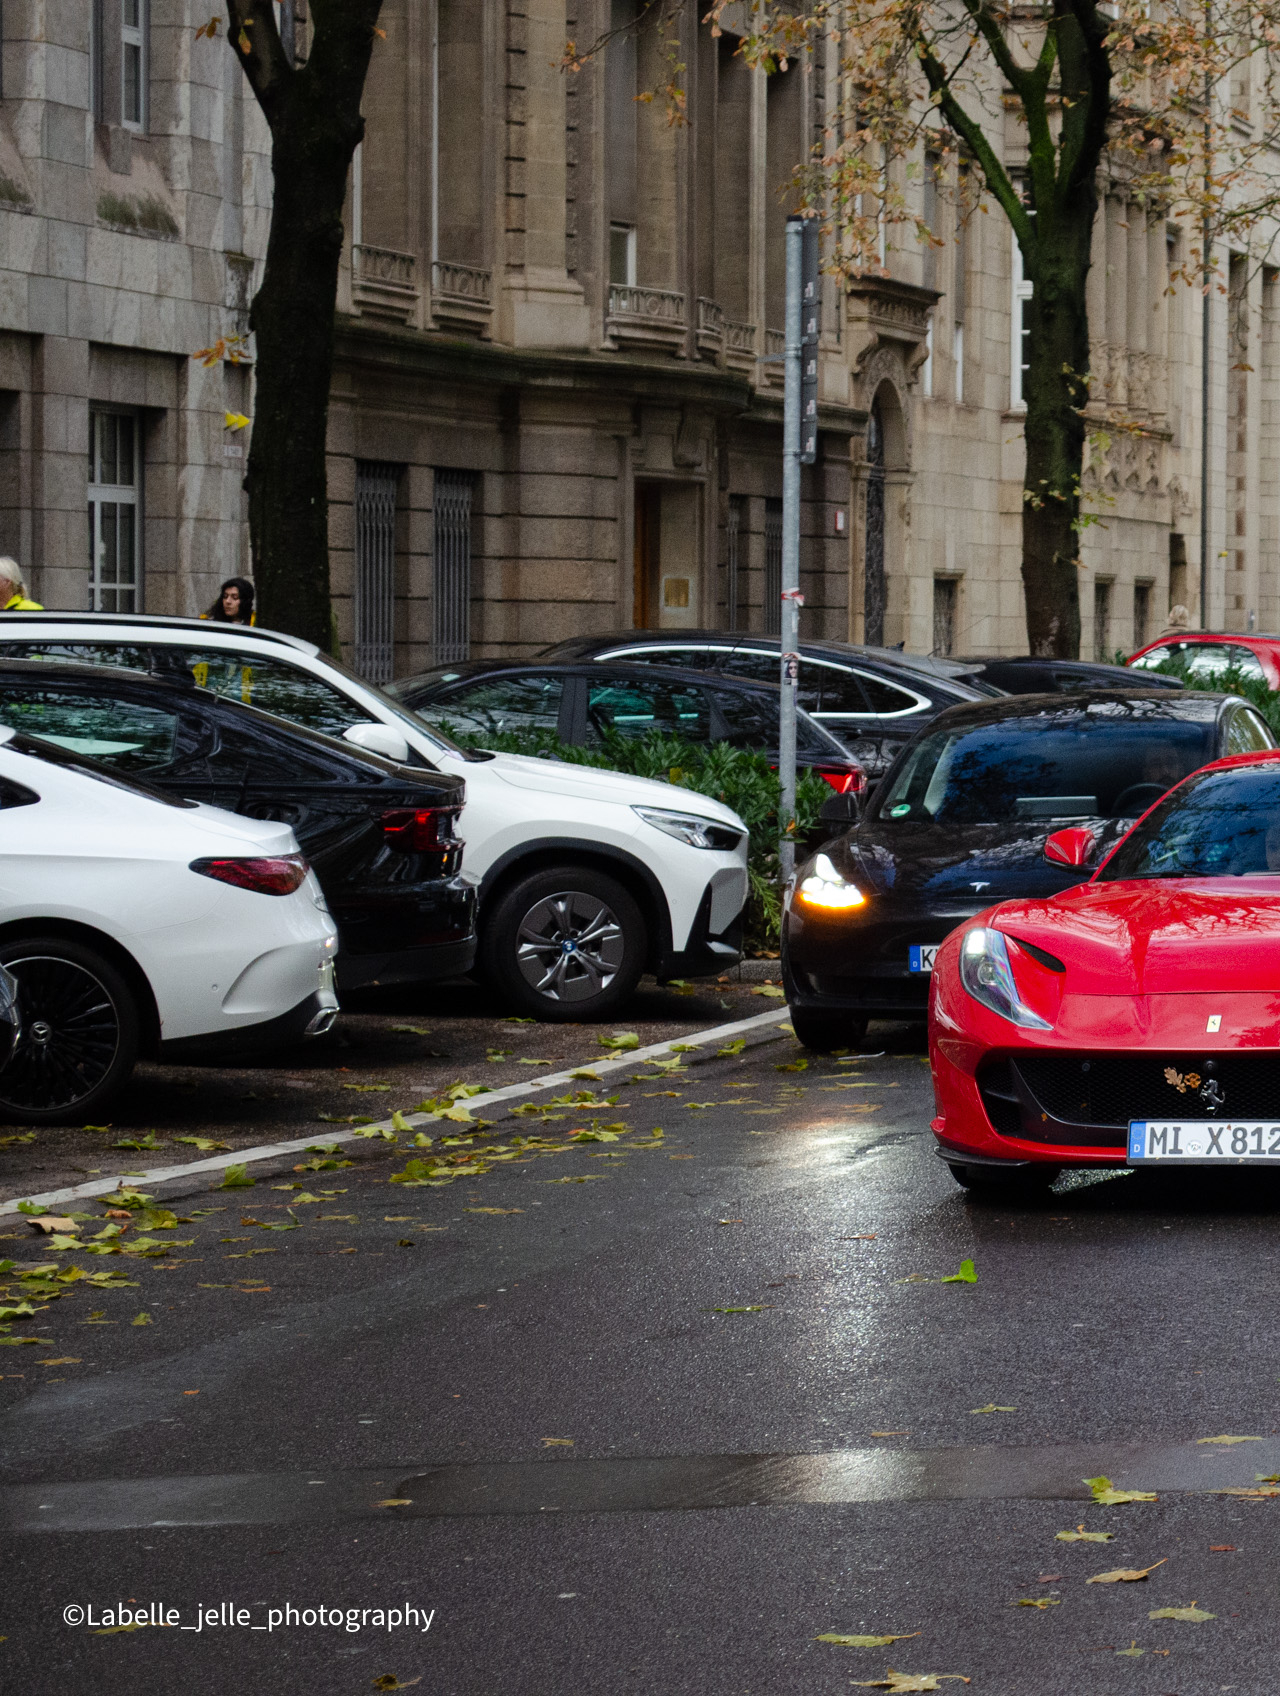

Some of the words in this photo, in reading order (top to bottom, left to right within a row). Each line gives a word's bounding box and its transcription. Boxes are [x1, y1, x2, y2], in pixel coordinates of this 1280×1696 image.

[922, 949, 939, 968] K
[1133, 1144, 1141, 1153] D
[1148, 1126, 1184, 1155] MI
[1205, 1126, 1224, 1155] X
